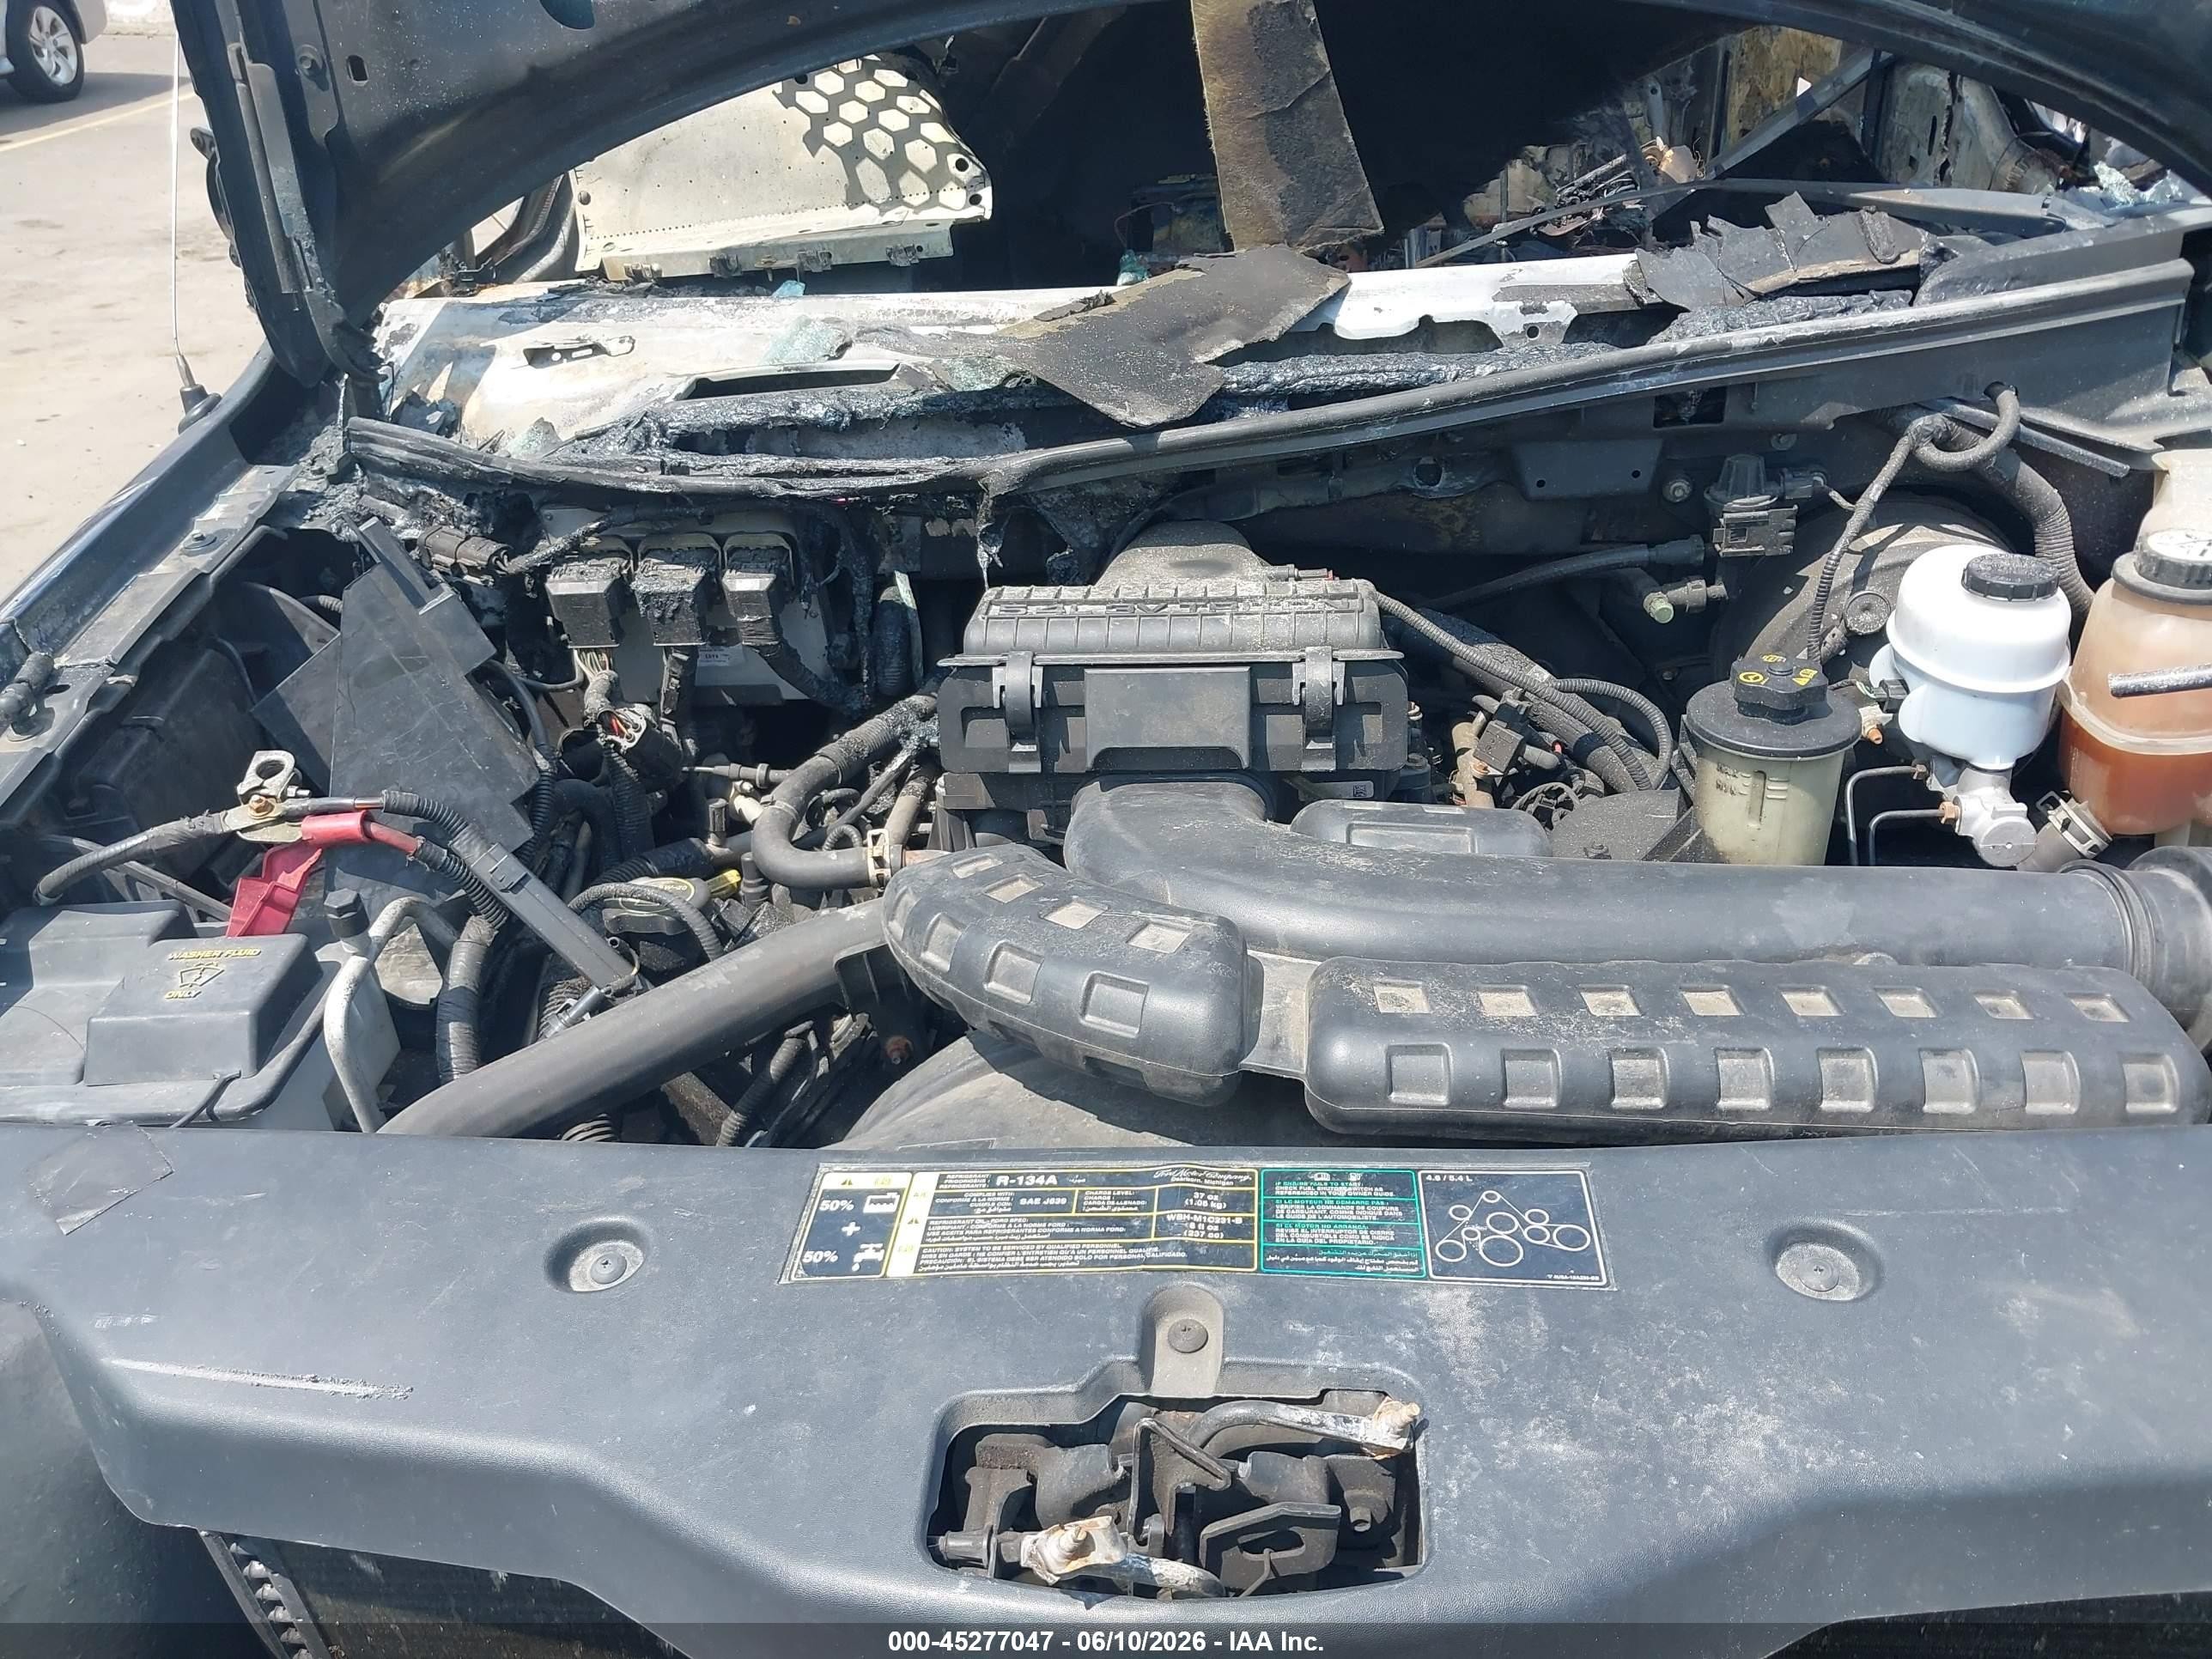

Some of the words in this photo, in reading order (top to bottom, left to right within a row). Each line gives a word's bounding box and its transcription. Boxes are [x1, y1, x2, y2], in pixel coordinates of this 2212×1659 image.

[168, 950, 223, 961] WASHER
[224, 948, 261, 957] FLUID
[164, 990, 202, 1000] ONLY
[995, 1175, 1058, 1187] R-134A
[819, 1200, 854, 1212] 50%
[1211, 1200, 1227, 1209] kg)
[802, 1250, 839, 1263] 50%
